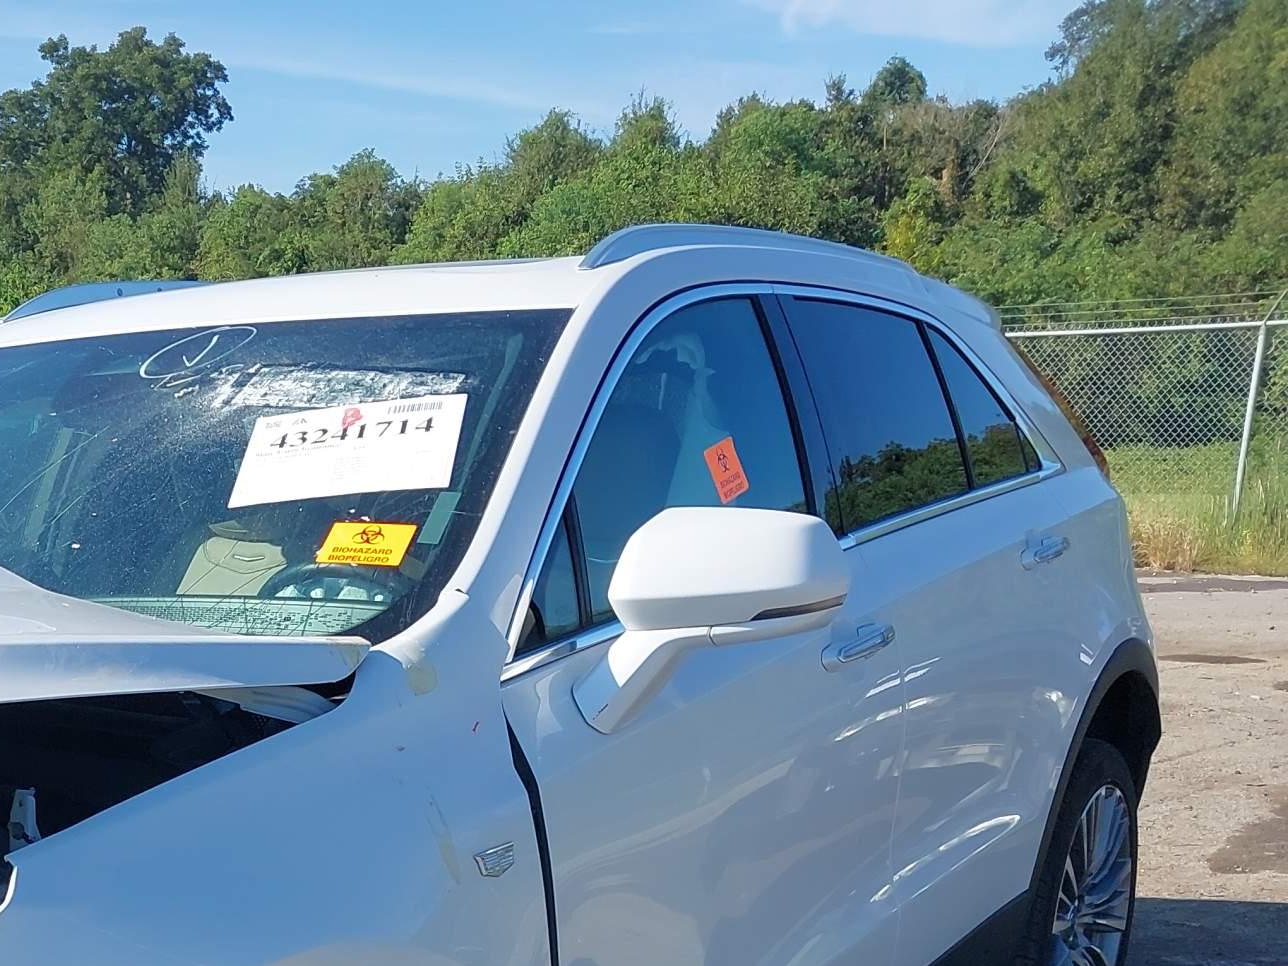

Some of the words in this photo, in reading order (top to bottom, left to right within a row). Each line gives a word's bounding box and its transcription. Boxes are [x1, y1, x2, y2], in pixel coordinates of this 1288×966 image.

[270, 416, 434, 449] 43241714
[332, 546, 392, 555] BIOHAZARD
[328, 554, 389, 563] BIOPELIGRO
